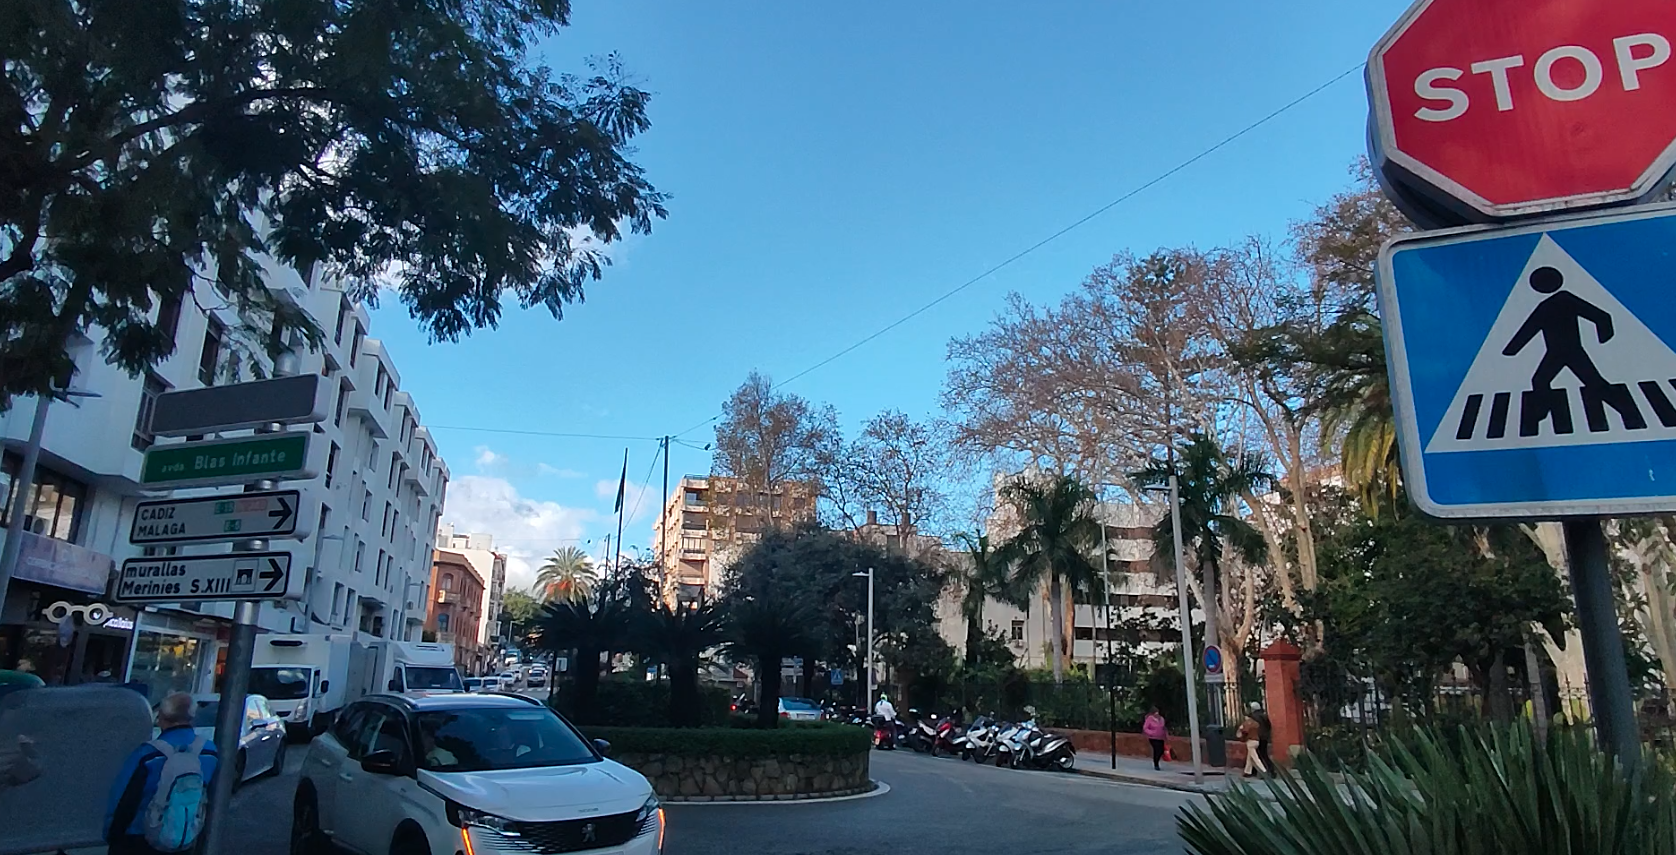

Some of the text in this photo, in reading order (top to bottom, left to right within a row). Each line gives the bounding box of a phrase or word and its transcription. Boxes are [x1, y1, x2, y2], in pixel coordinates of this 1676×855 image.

[1414, 32, 1671, 122] STOP
[194, 455, 226, 470] Blas
[232, 449, 286, 467] Infante
[141, 507, 176, 521] CADIZ
[137, 523, 186, 536] MALAGA
[125, 563, 186, 578] murallas
[121, 578, 231, 596] Merinies S.XIII
